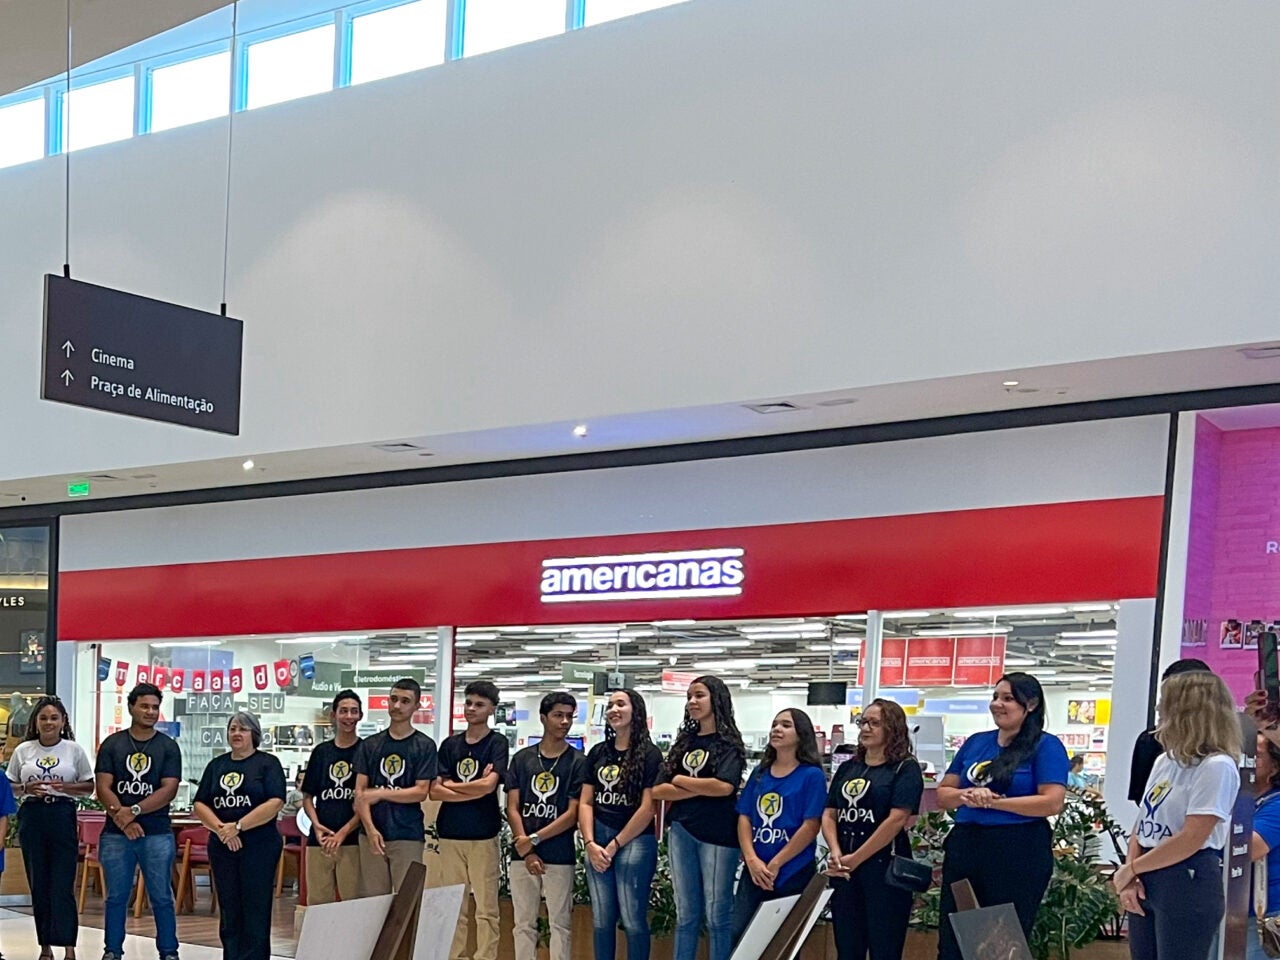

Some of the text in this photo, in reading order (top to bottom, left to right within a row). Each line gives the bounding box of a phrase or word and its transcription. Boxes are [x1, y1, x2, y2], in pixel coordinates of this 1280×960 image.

[91, 349, 134, 370] Cinema
[91, 376, 214, 413] Praça de Alimentação
[540, 559, 745, 593] americanas
[188, 695, 283, 711] FAÇA SEU
[117, 780, 153, 796] CAOPA
[213, 795, 252, 809] CAOPA
[522, 802, 557, 819] CAOPA
